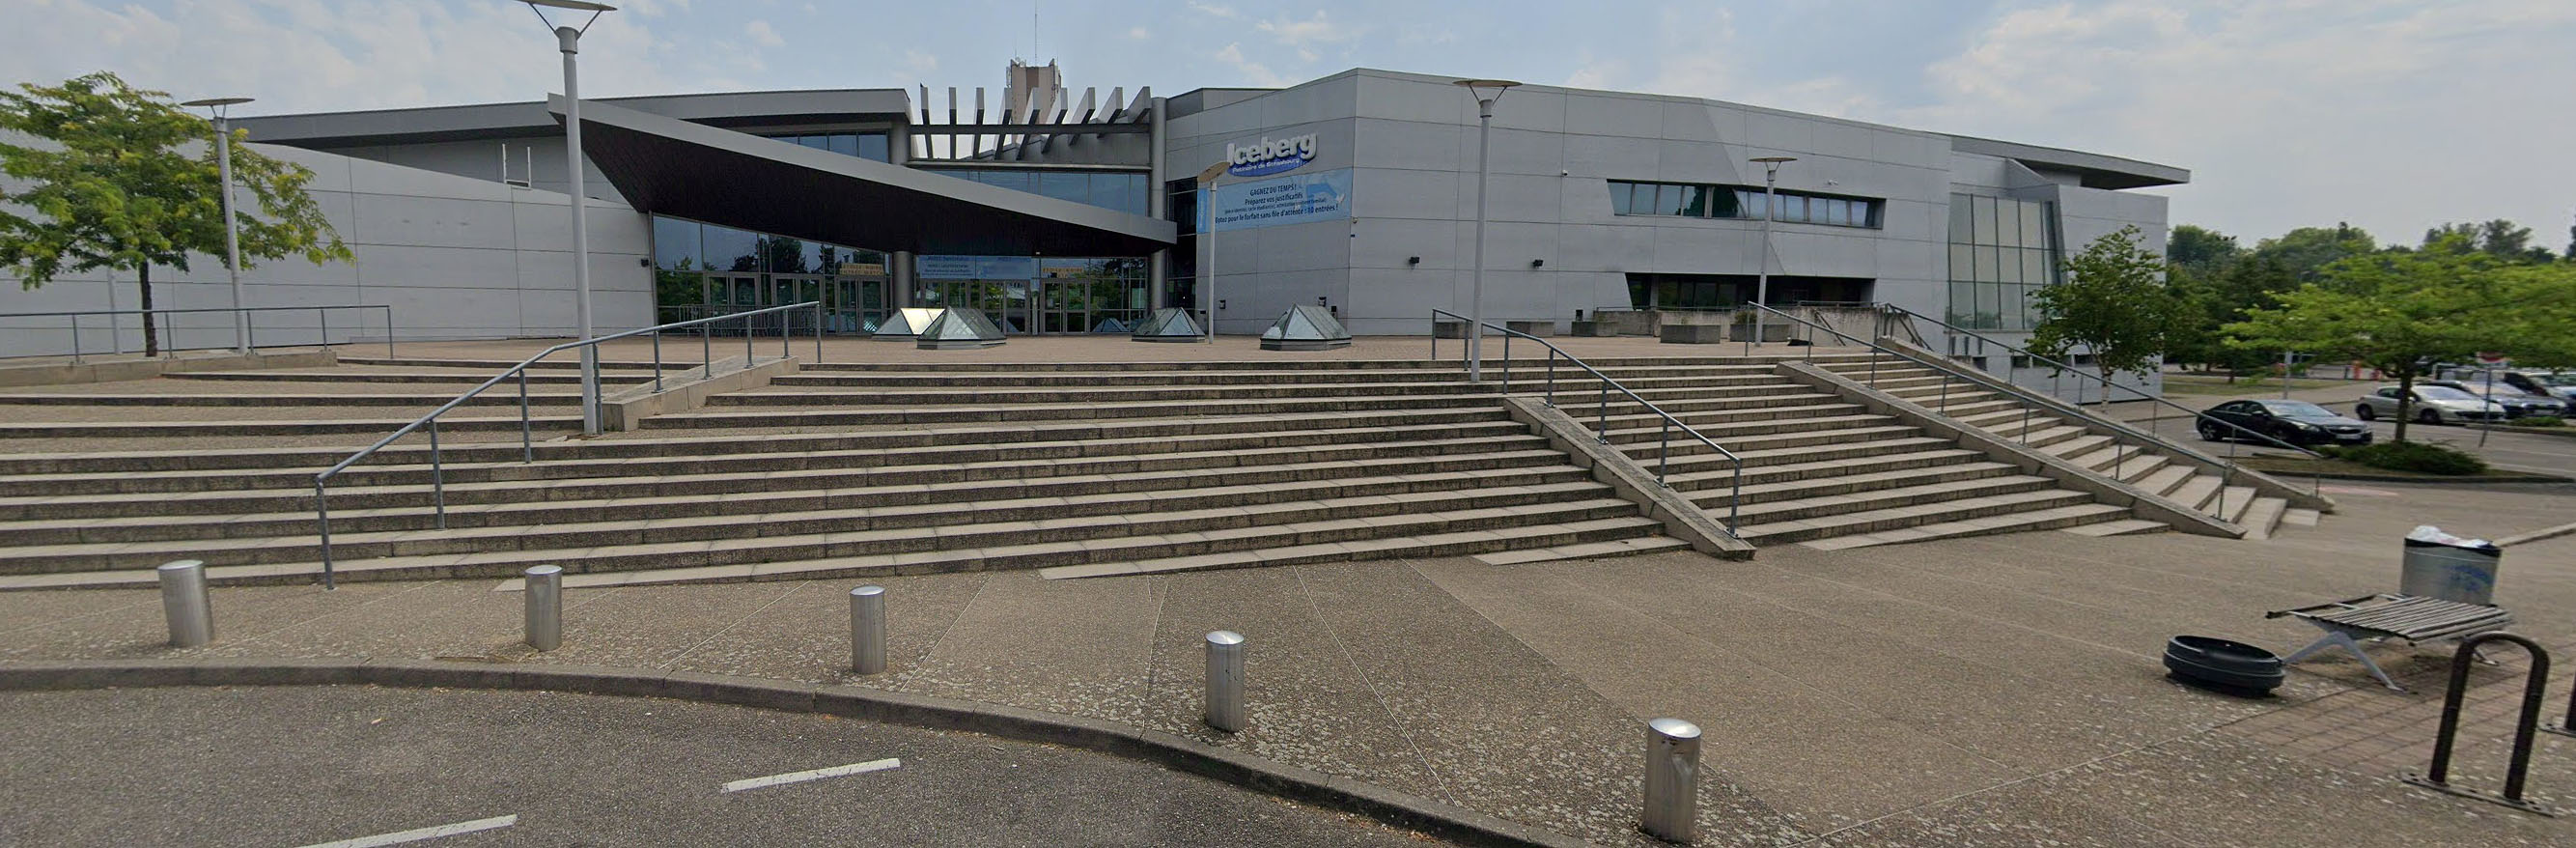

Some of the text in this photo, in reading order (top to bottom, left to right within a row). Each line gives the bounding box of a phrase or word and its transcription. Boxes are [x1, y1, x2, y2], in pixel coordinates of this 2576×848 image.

[1227, 133, 1317, 166] Iceberg
[1232, 163, 1257, 173] Patinoire
[1266, 158, 1300, 167] Strasbourg
[1250, 187, 1269, 196] GAGNEZ
[1245, 197, 1266, 205] Préparez
[1275, 192, 1303, 202] justificatifs
[1245, 212, 1260, 220] forfait
[1272, 209, 1280, 217] file
[1280, 207, 1303, 217] d'attente
